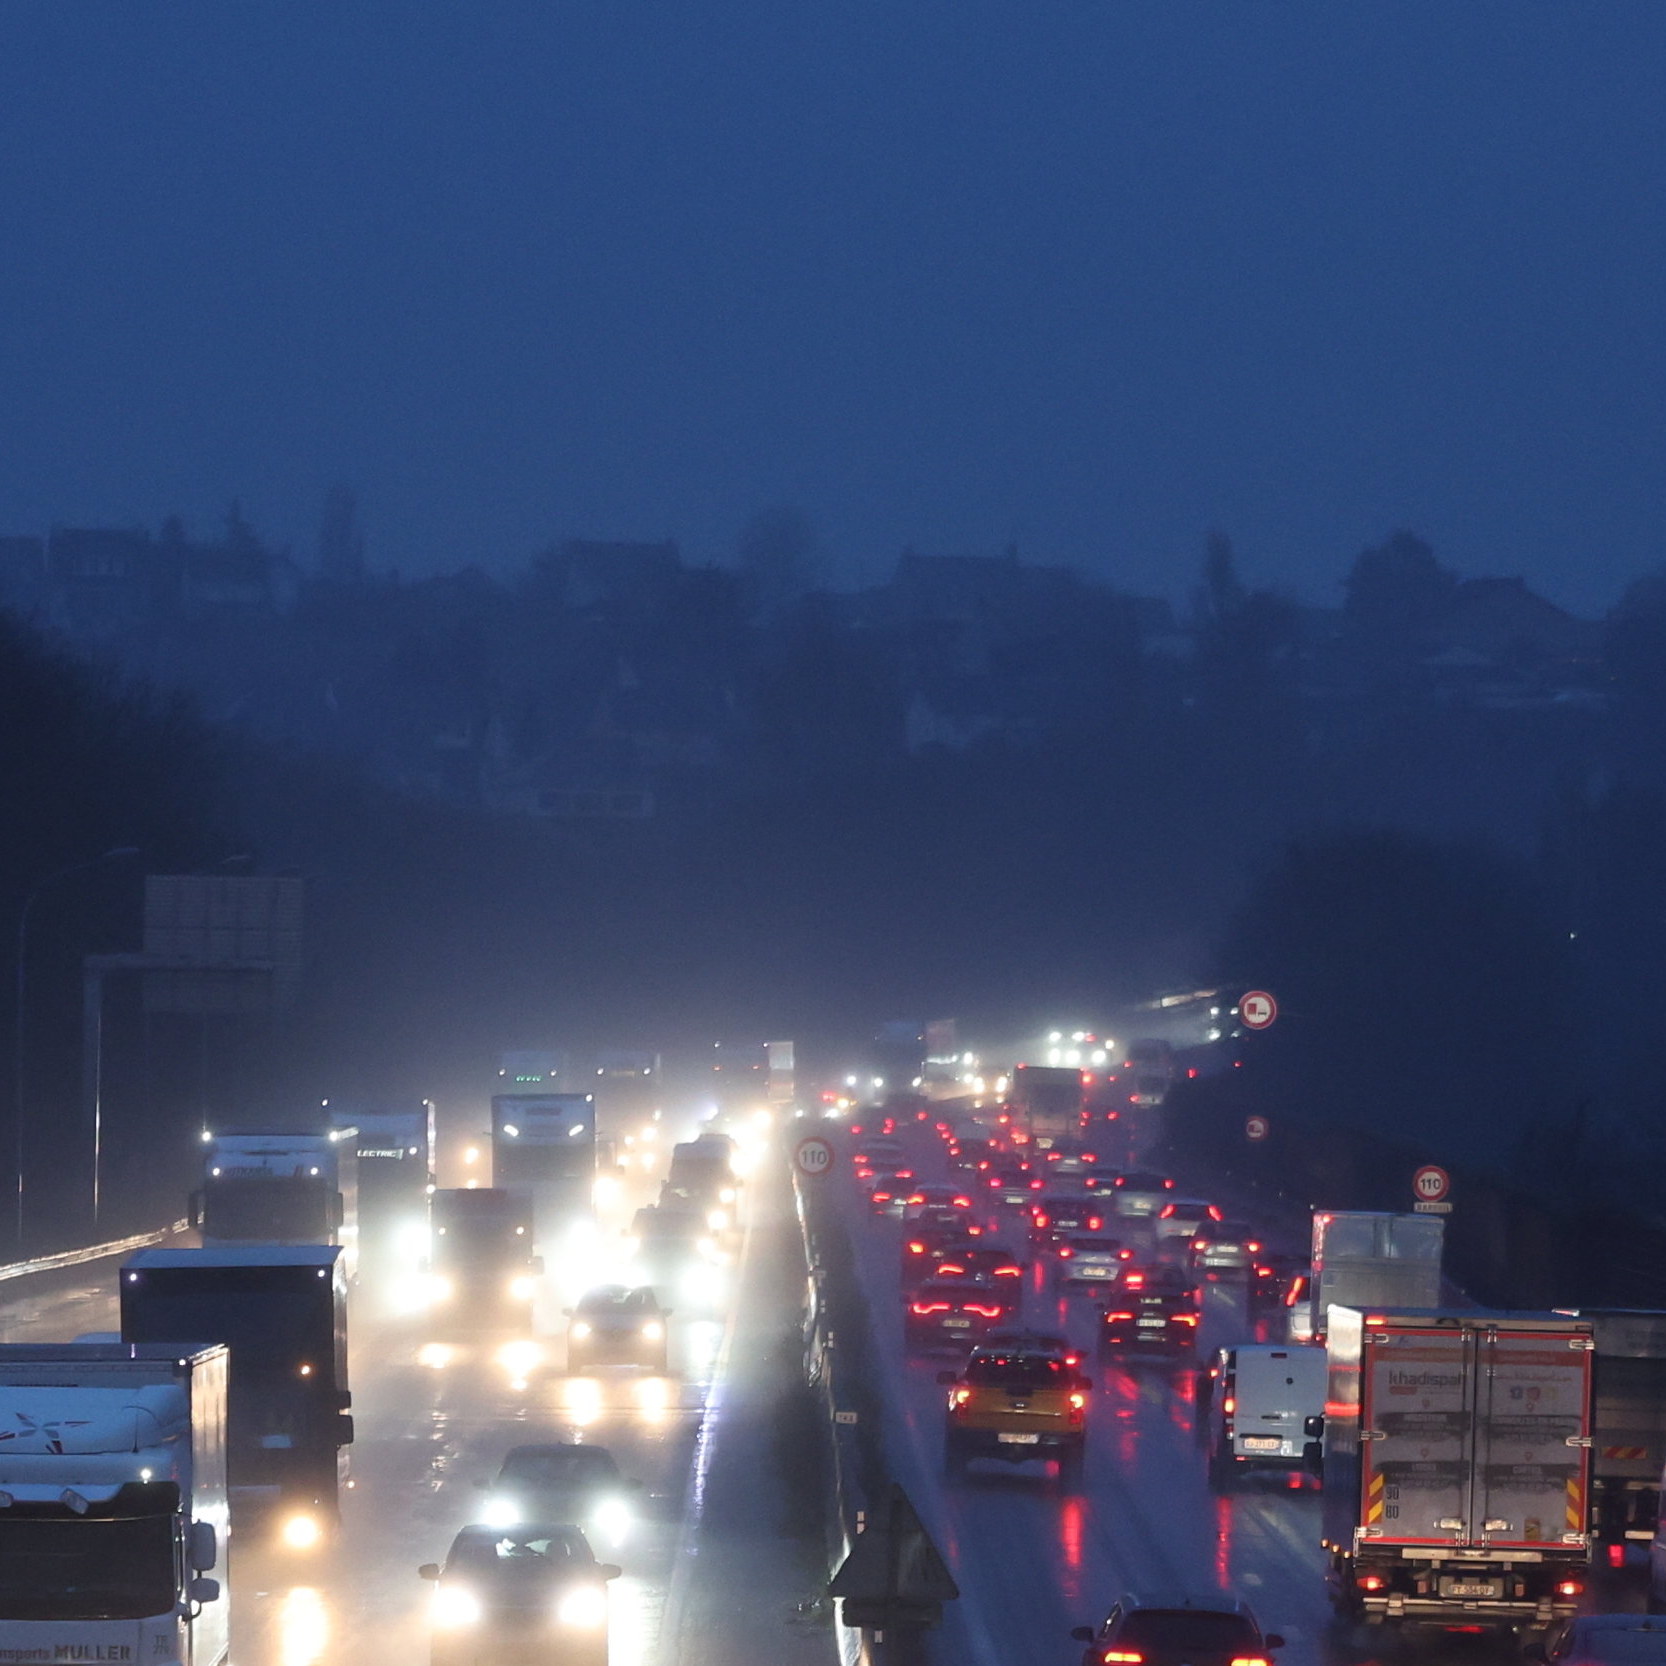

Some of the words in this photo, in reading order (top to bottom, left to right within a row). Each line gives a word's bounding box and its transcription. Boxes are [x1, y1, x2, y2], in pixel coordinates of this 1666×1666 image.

[802, 1150, 827, 1165] 110
[1420, 1178, 1441, 1191] 110
[1386, 1486, 1400, 1500] 90
[1385, 1504, 1400, 1519] 80
[53, 1644, 131, 1661] MULLER
